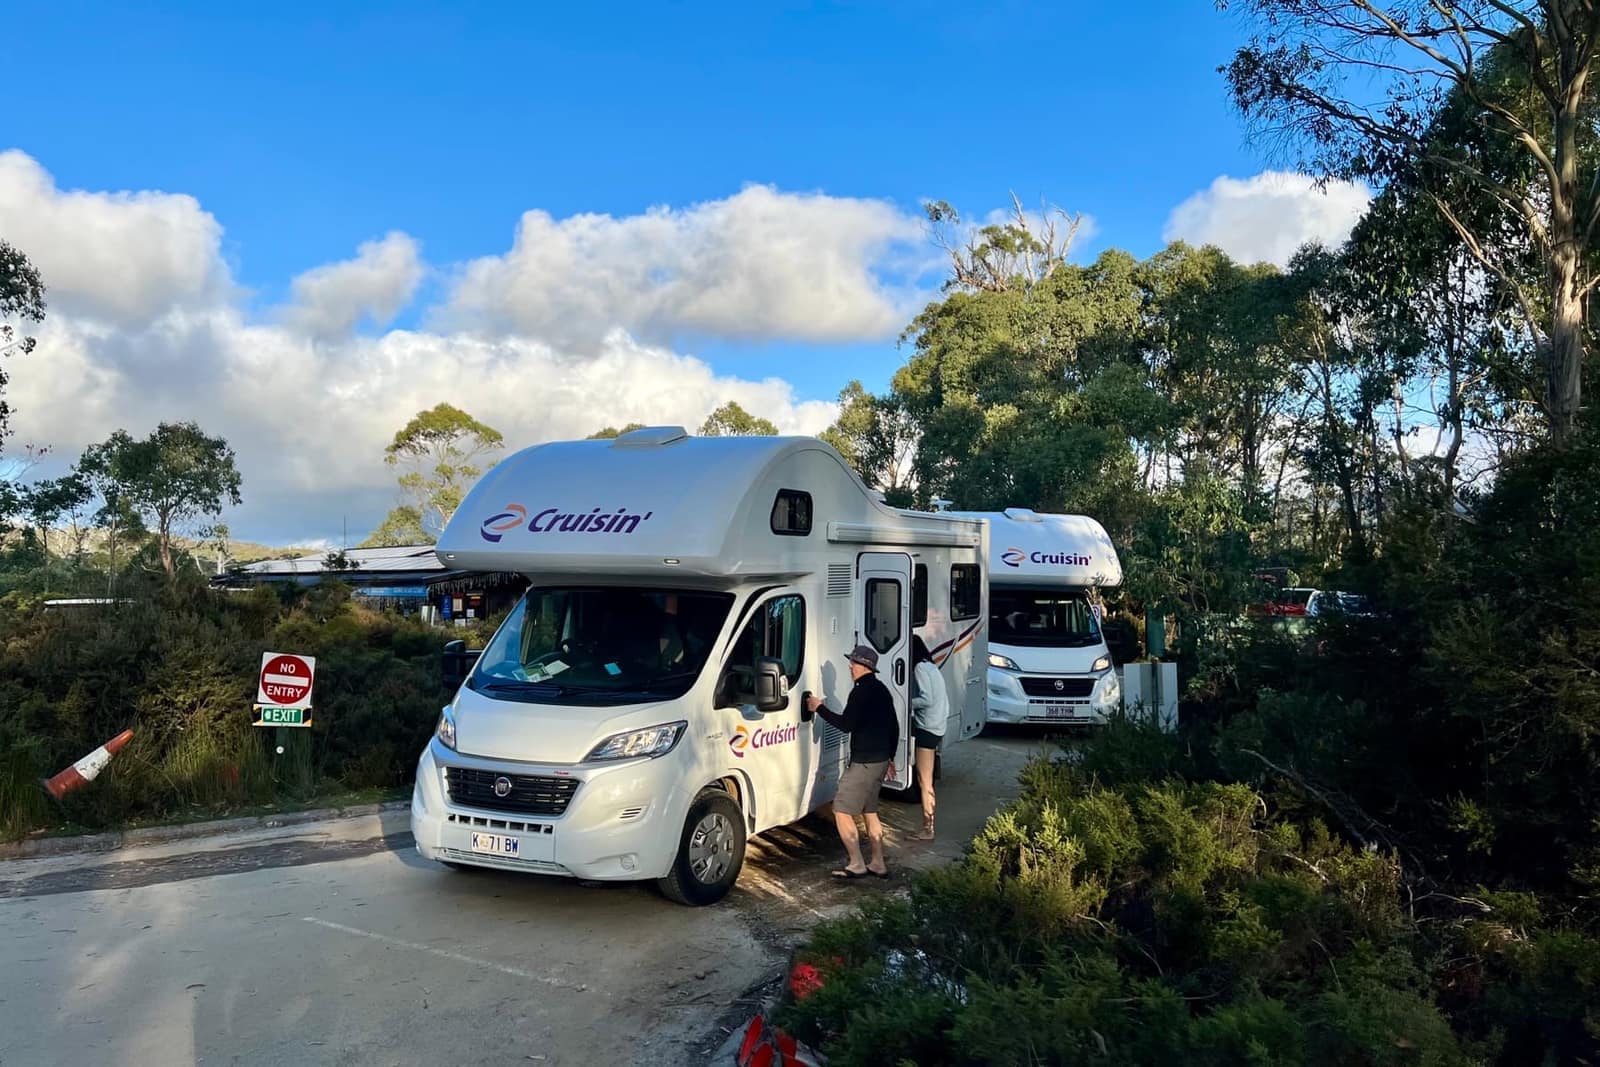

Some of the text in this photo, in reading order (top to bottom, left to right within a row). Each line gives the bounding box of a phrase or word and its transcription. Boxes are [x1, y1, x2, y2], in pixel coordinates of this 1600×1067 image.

[527, 507, 653, 534] Cruisin'
[1030, 551, 1092, 566] Cruisin'
[280, 663, 296, 674] NO
[266, 685, 303, 698] ENTRY
[272, 709, 298, 722] EXIT
[752, 722, 800, 749] Cruisin'
